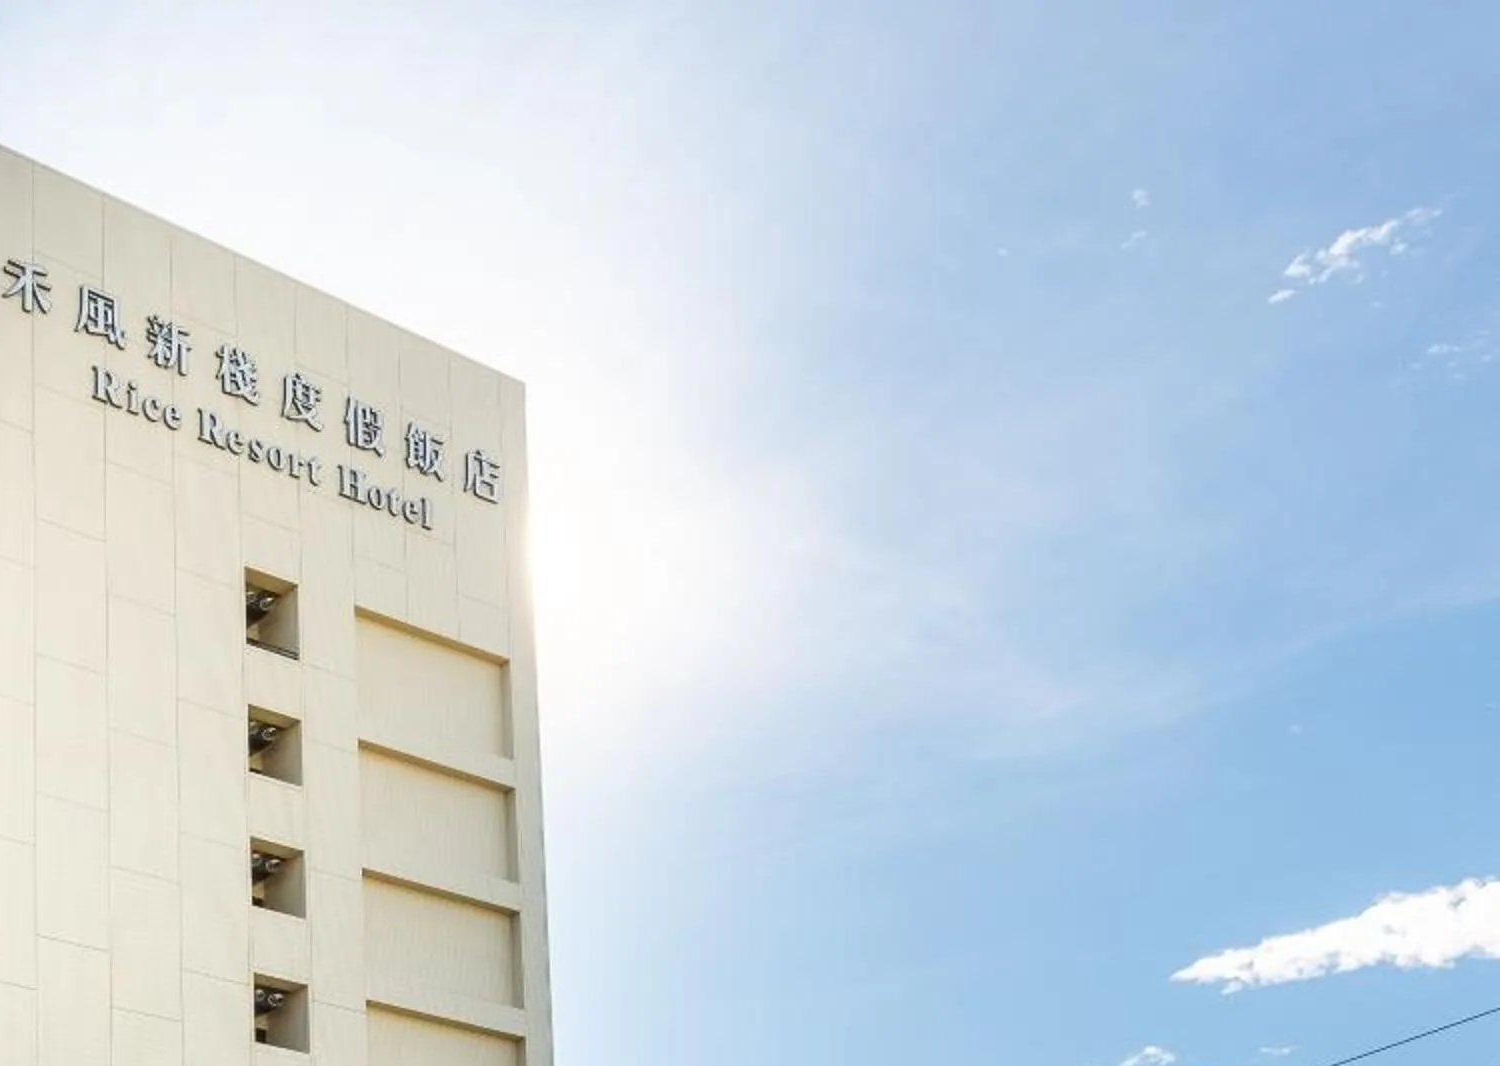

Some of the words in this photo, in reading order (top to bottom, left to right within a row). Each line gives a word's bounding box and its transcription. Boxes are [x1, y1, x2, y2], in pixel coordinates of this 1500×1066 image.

[2, 257, 501, 504] 禾風新棧度假飯店
[91, 363, 182, 430] Rice
[197, 406, 323, 487] Resort
[338, 464, 434, 531] Hotel
